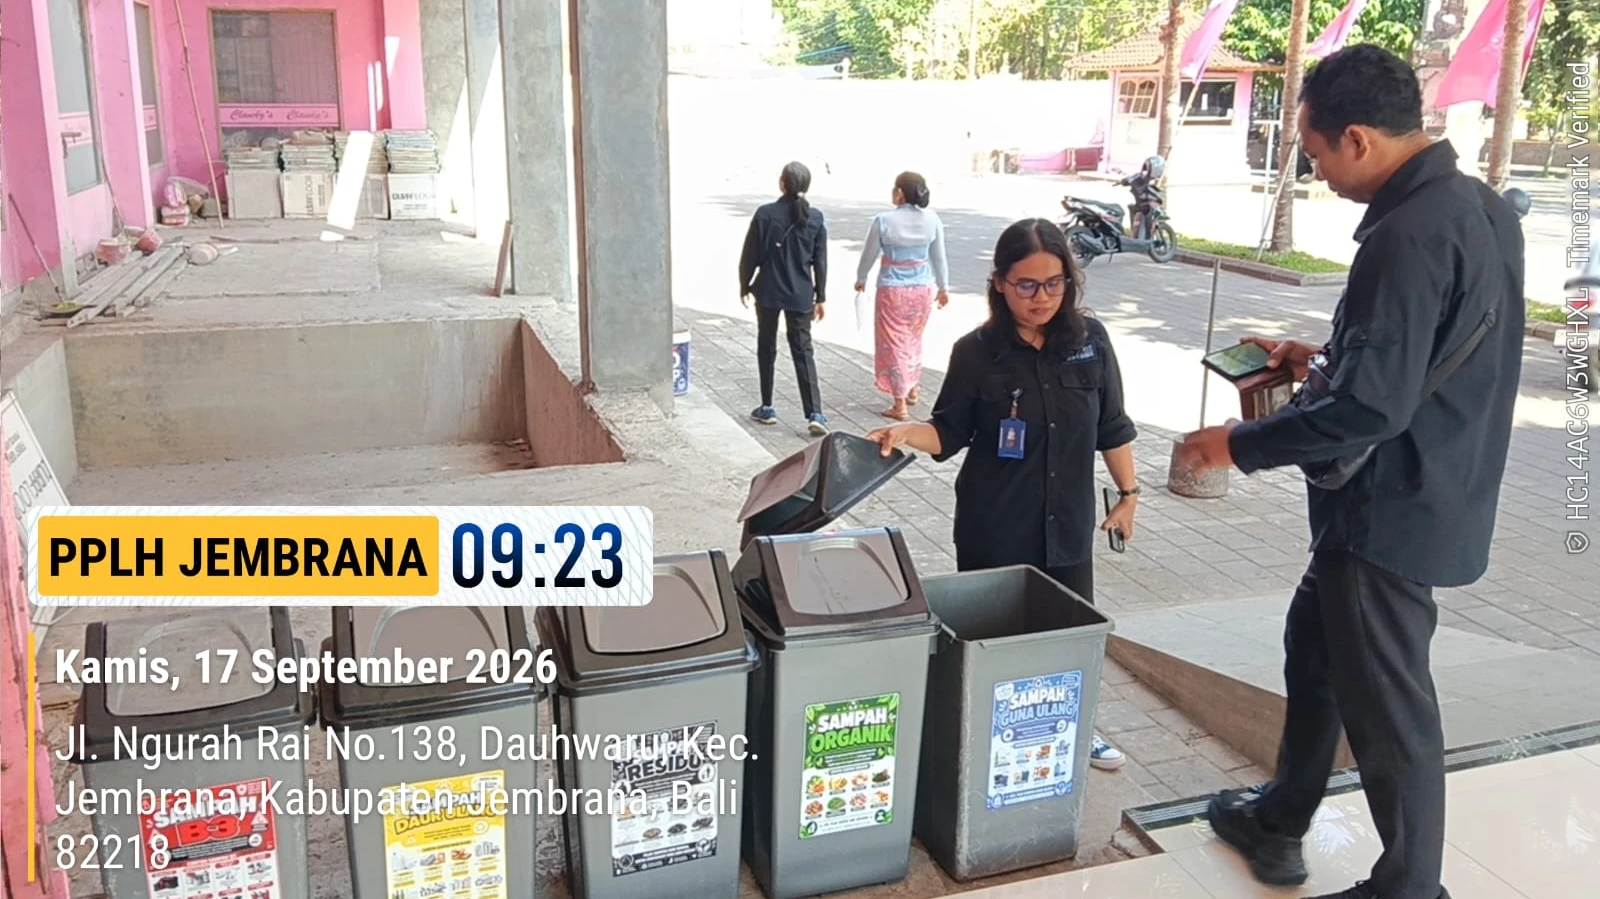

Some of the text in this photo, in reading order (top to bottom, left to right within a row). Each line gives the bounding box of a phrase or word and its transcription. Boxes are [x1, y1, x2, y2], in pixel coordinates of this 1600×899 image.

[1009, 686, 1067, 710] SAMPAH
[817, 706, 888, 733] SAMPAH
[1000, 702, 1074, 728] GUNA ULANG
[810, 724, 893, 755] ORGANIK
[626, 752, 703, 782] RESIDU
